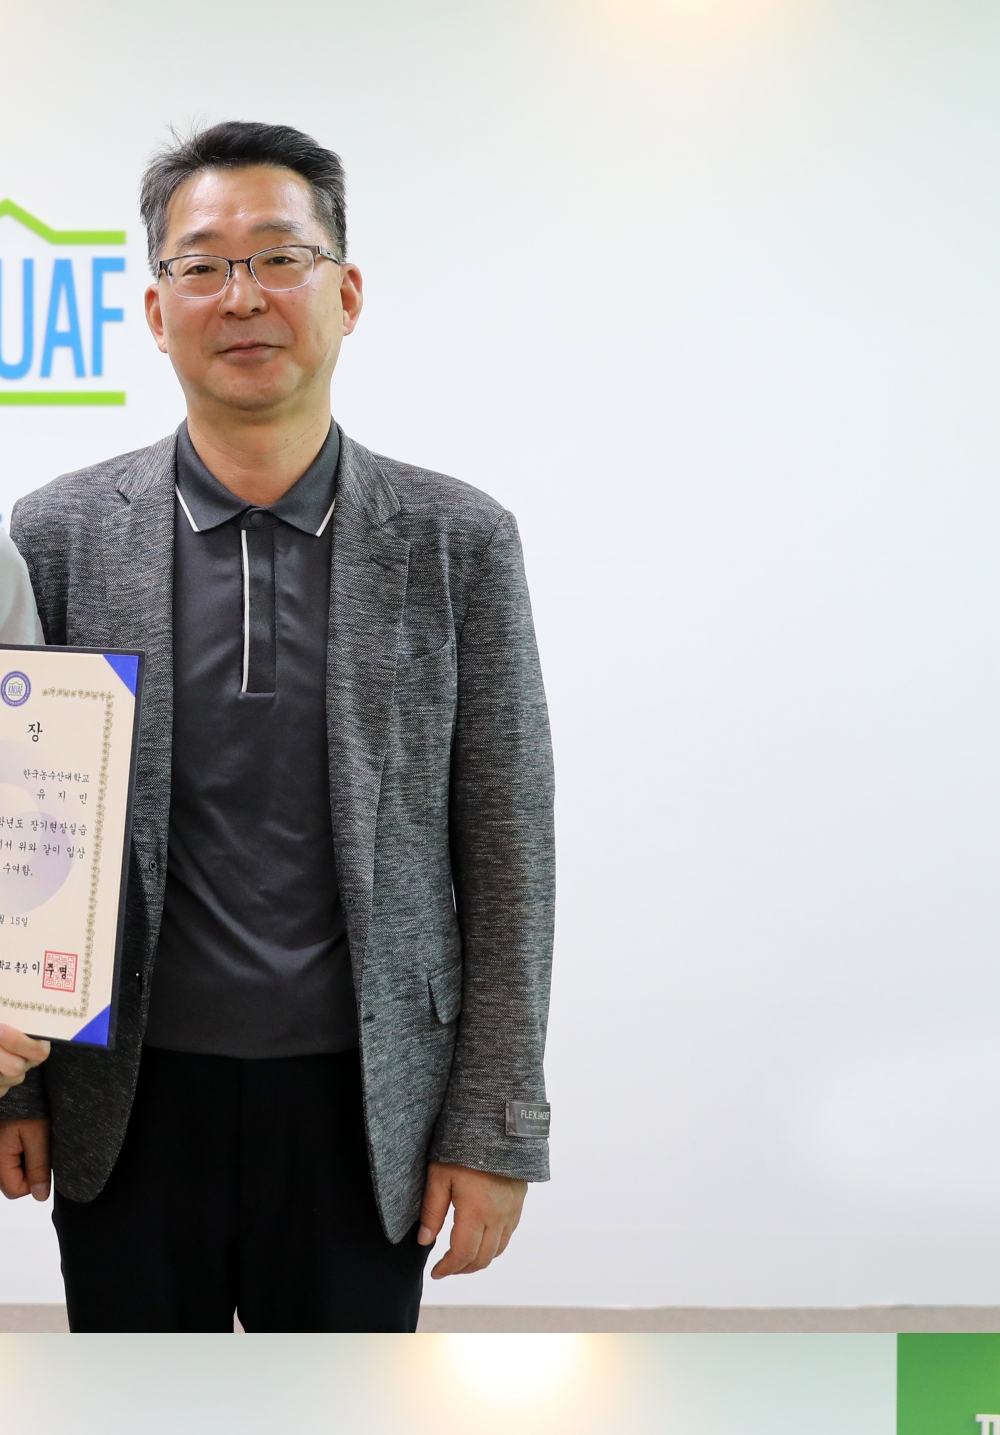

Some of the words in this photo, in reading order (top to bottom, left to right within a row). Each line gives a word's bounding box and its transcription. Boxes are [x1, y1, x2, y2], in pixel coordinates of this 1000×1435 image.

[26, 722, 43, 742] 장
[23, 769, 89, 783] 한국농수산대학교
[37, 789, 45, 800] 유
[58, 791, 65, 800] 지
[80, 793, 87, 804] 민
[31, 820, 87, 836] 장기현장실습
[19, 841, 37, 852] 위와
[43, 844, 60, 856] 같이
[67, 847, 85, 859] 입상
[3, 862, 33, 876] 수여함.
[10, 916, 28, 927] 15일
[15, 962, 28, 974] 총장
[32, 961, 40, 975] 이
